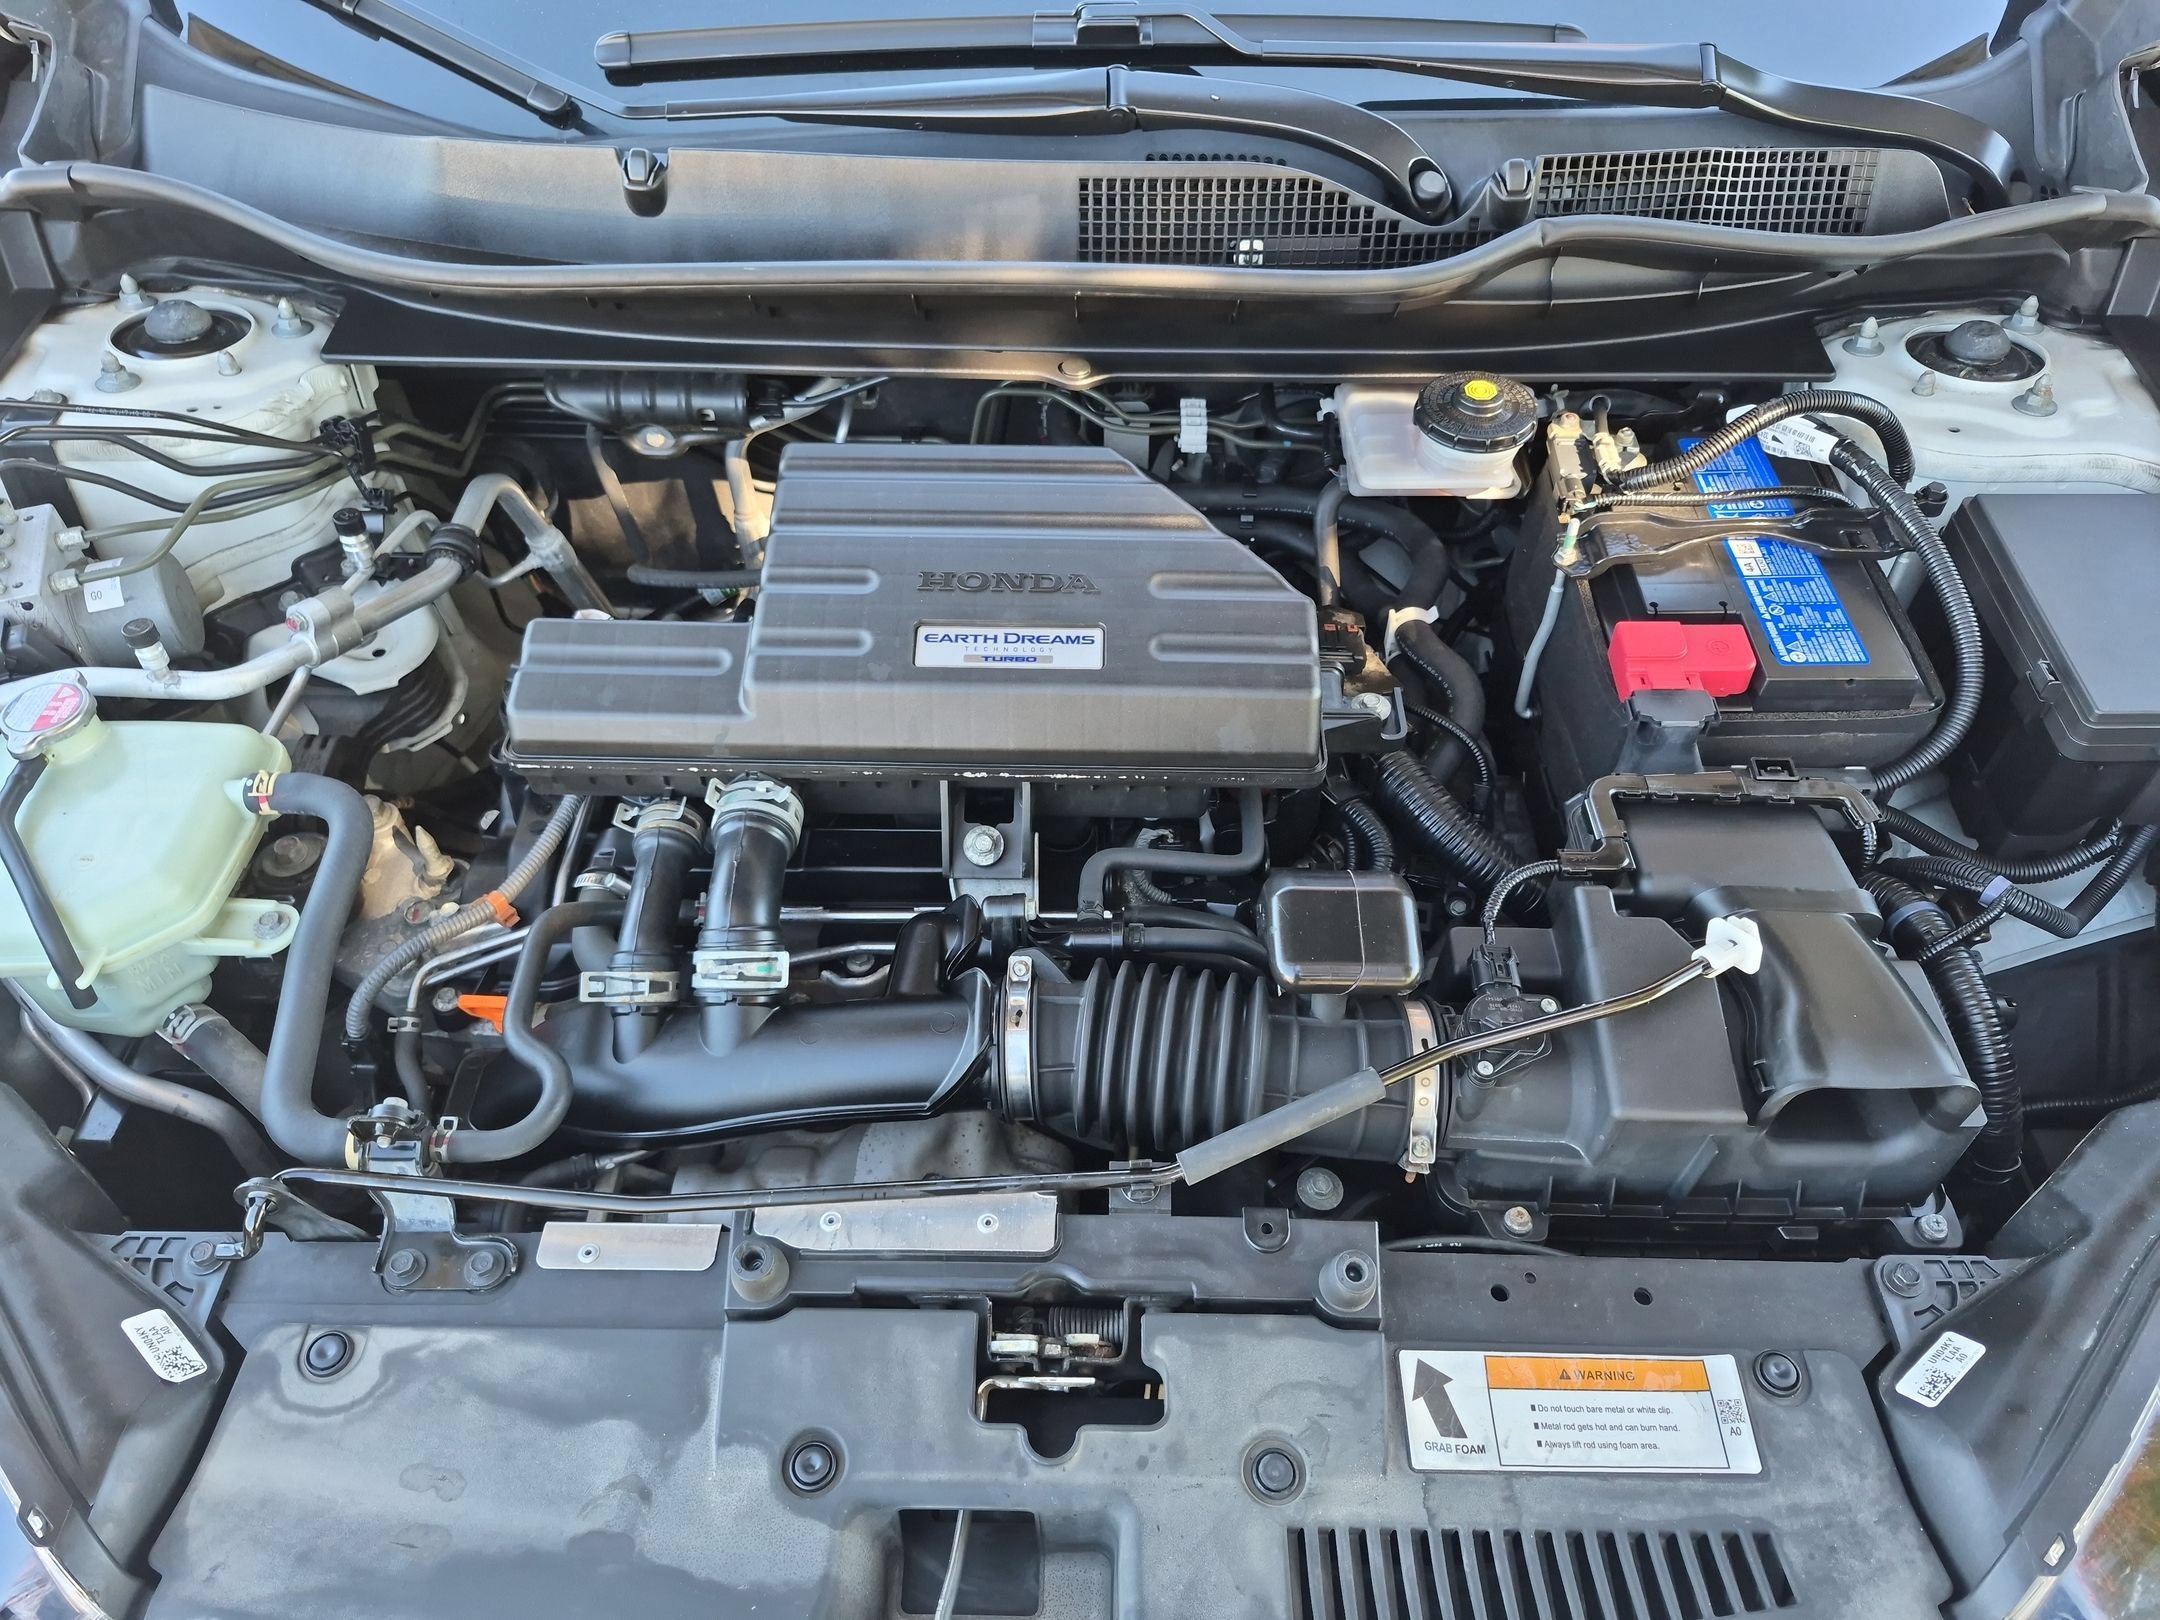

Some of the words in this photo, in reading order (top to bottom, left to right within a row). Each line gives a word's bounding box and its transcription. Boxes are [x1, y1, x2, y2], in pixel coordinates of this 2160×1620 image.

[917, 571, 1101, 593] HONDA
[924, 633, 998, 644] EARTH
[1003, 632, 1095, 645] DREAMS
[981, 655, 1038, 663] TURBO
[148, 1326, 167, 1345] TLAA
[1941, 1345, 1962, 1363] TLAA
[1574, 1369, 1635, 1381] WARNING
[1537, 1404, 1549, 1412] Do
[1550, 1405, 1562, 1413] not
[1563, 1405, 1584, 1413] touch
[1586, 1405, 1603, 1413] bare
[1605, 1406, 1625, 1414] metal
[1637, 1406, 1656, 1414] white
[1658, 1406, 1673, 1415] clip.
[1541, 1422, 1561, 1430] Metal
[1563, 1422, 1576, 1430] rod
[1577, 1423, 1594, 1432] gets
[1595, 1423, 1607, 1431] hot
[1640, 1424, 1657, 1432] burn
[1659, 1424, 1681, 1432] hand.
[1424, 1441, 1453, 1453] GRAB
[1455, 1444, 1487, 1455] FOAM
[1544, 1440, 1571, 1450] Always
[1572, 1440, 1582, 1449] lift
[1583, 1440, 1596, 1449] rod
[1597, 1441, 1618, 1451] using
[1619, 1441, 1639, 1450] foam
